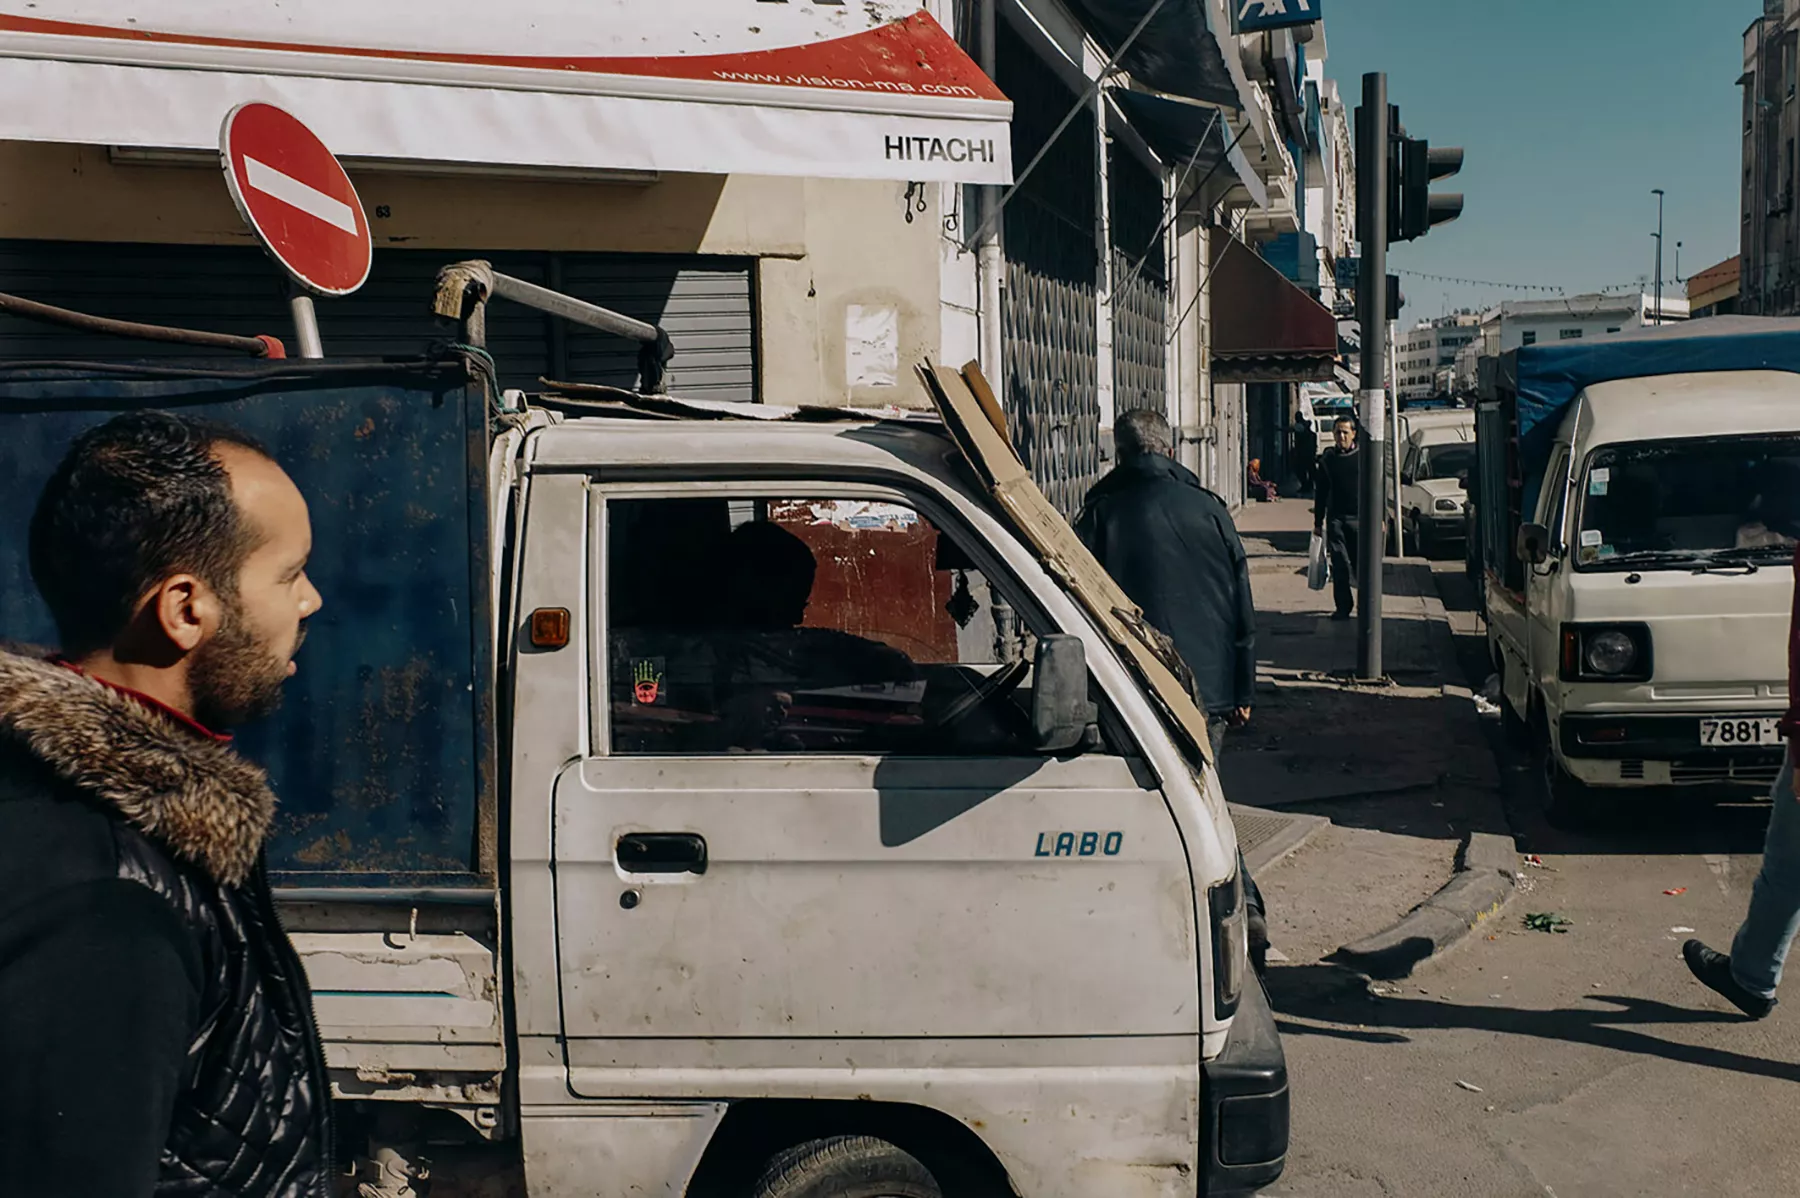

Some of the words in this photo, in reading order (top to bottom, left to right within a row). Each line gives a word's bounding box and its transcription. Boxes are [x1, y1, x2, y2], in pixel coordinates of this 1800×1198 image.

[713, 71, 976, 96] www.vision-ma.com
[885, 135, 994, 163] HITACHI
[375, 204, 391, 218] 63
[1035, 831, 1123, 857] LABO
